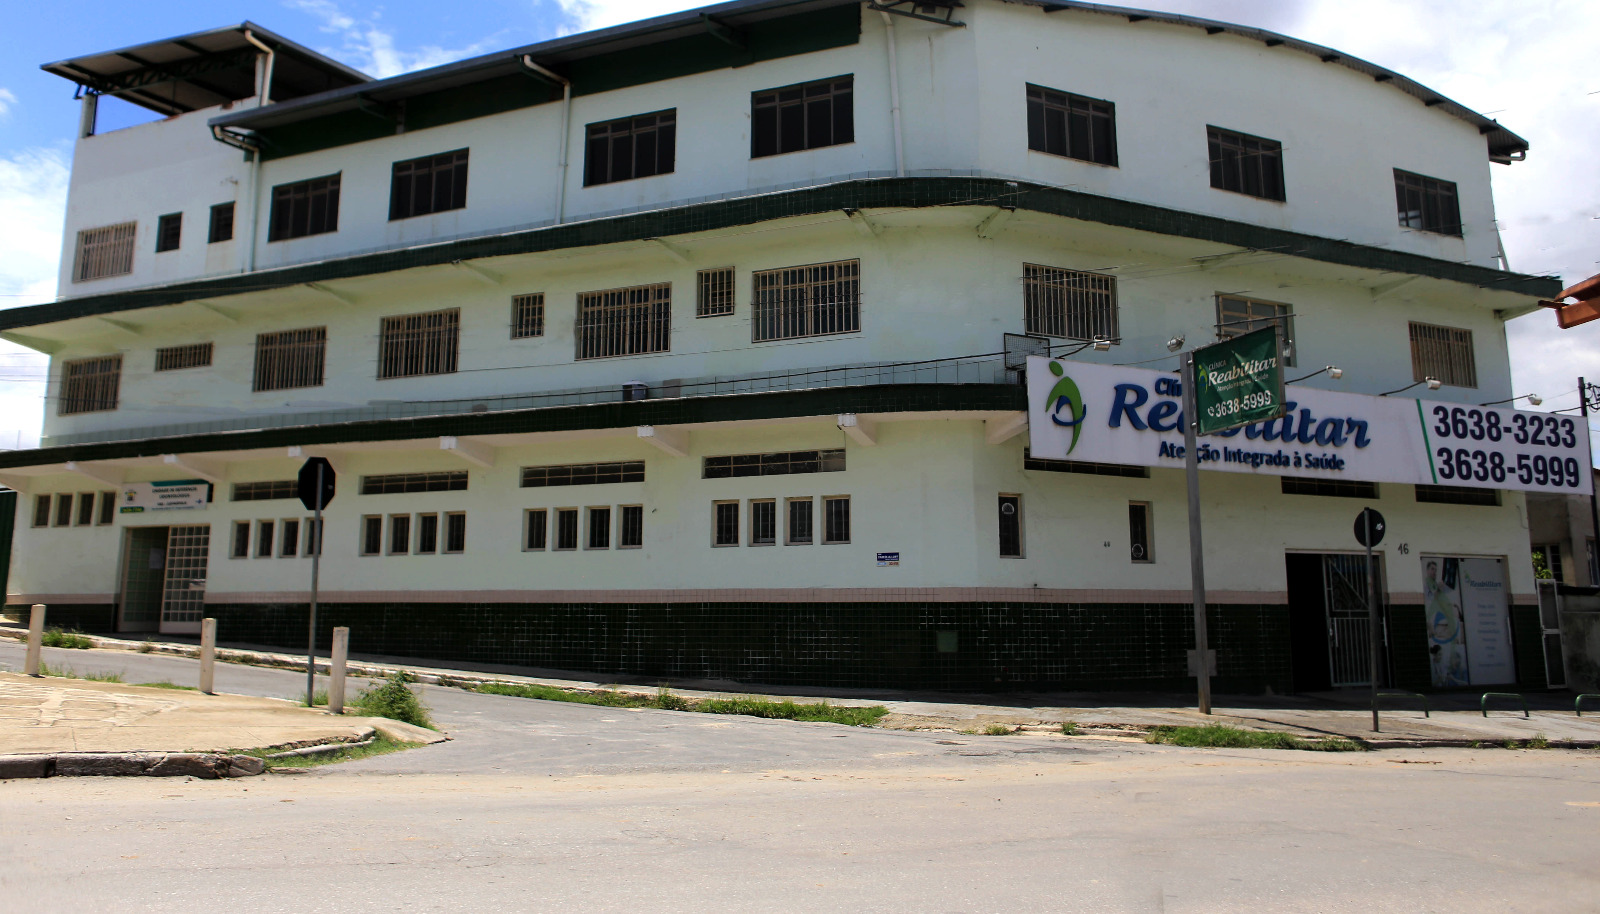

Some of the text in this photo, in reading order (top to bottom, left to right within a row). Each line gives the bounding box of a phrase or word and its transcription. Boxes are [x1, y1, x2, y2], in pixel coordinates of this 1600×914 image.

[1208, 360, 1226, 370] CLÍNICA
[1208, 357, 1277, 386] Reabilitar
[1215, 390, 1271, 417] 3638-5999
[1433, 405, 1576, 448] 3638-3233
[1158, 440, 1345, 470] Ateção Integrada à Saúde
[1437, 447, 1580, 488] 3638-5999
[1397, 543, 1409, 555] 46
